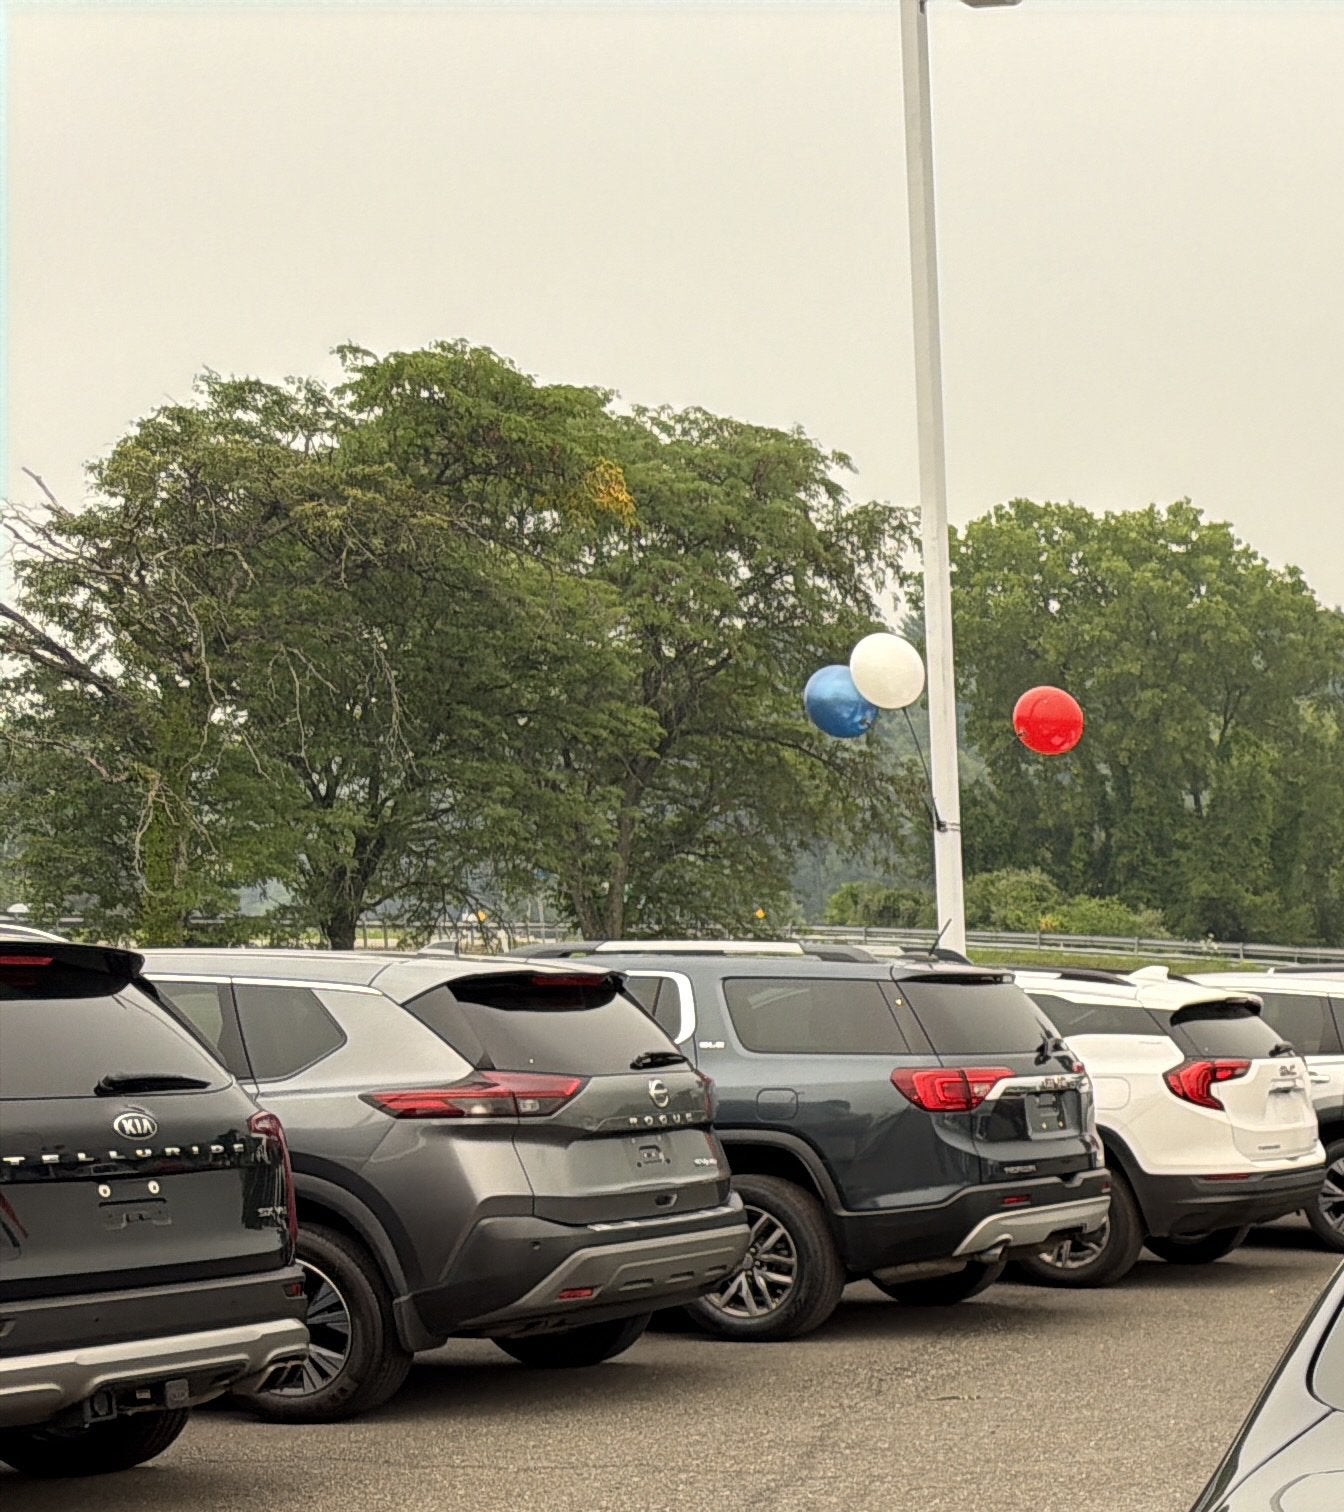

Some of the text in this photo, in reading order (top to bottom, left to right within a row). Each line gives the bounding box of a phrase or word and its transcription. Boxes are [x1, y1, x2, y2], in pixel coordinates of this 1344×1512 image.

[121, 1117, 154, 1135] KIA
[629, 1112, 693, 1127] ROGUE
[2, 1142, 244, 1166] TELLURIDE
